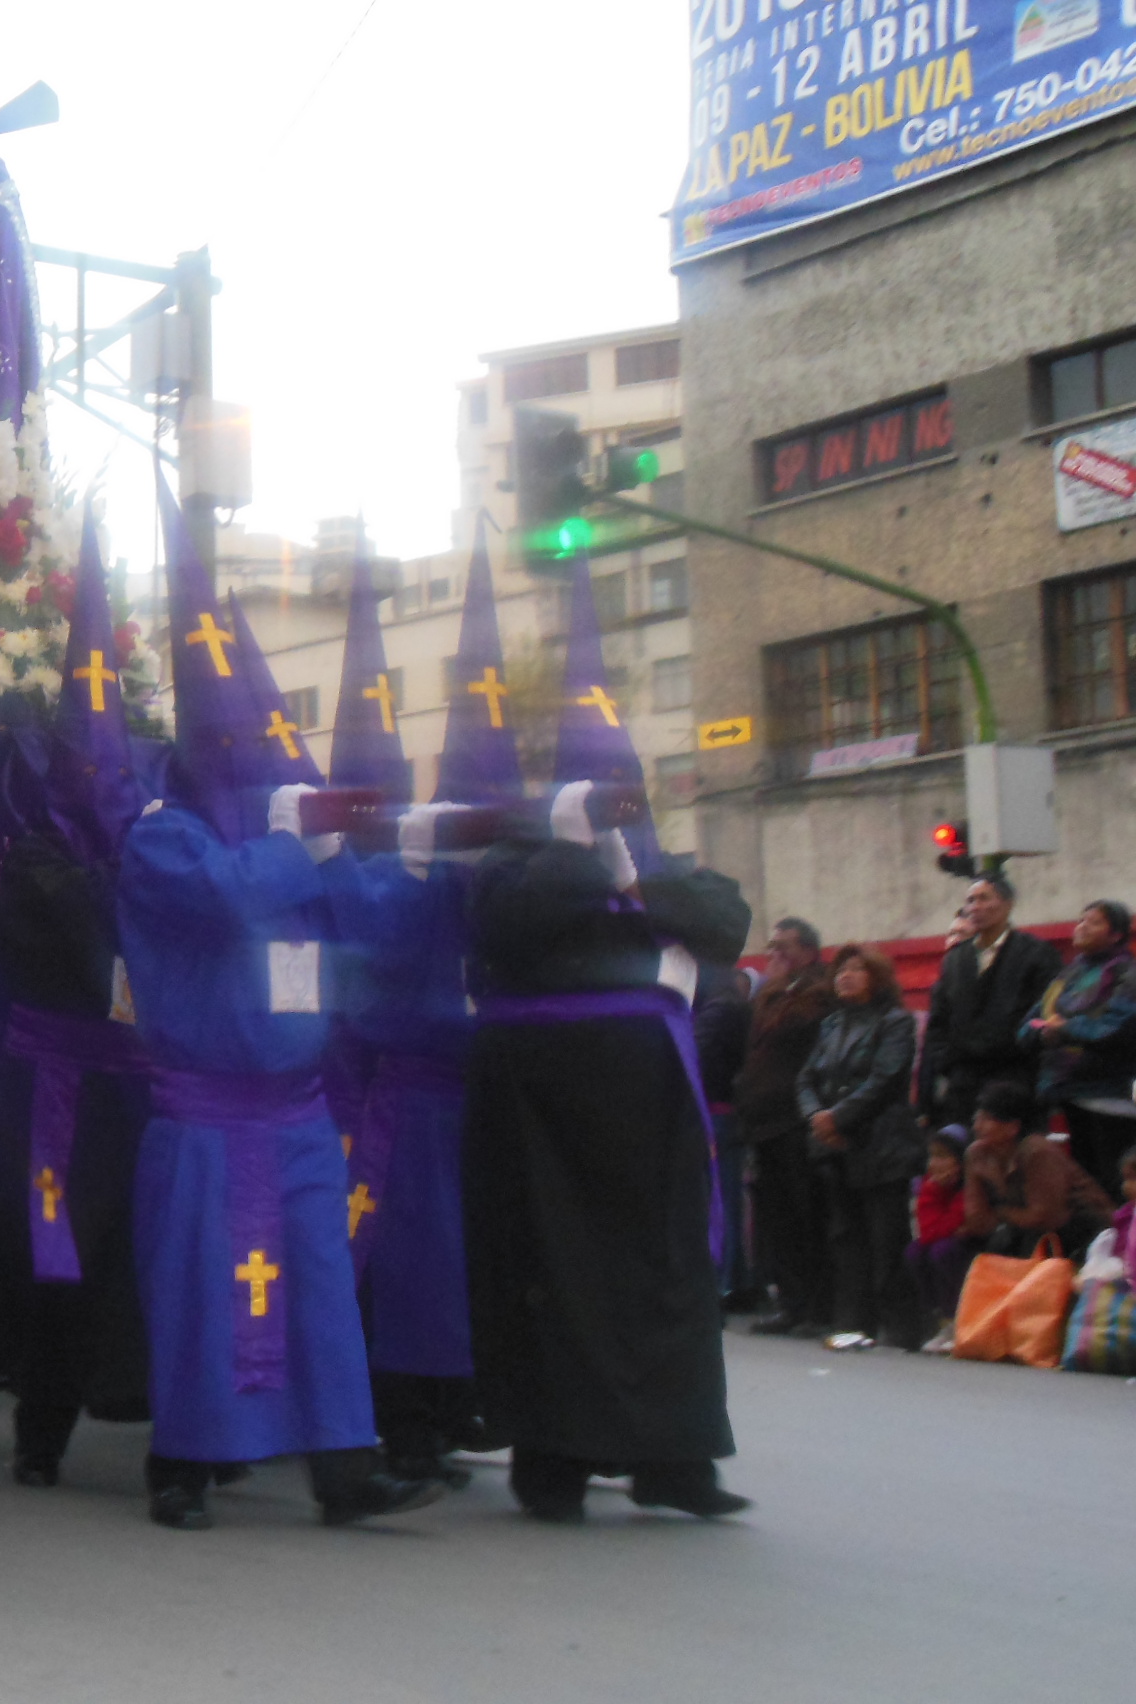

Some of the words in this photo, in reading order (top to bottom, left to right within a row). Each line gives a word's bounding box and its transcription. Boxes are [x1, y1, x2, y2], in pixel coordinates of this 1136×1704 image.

[685, 142, 728, 200] LA
[727, 111, 794, 184] PAZ
[825, 48, 973, 149] BOLIVIA
[693, 83, 731, 148] 09
[771, 44, 821, 108] 12
[838, 0, 979, 85] ABRIL
[900, 105, 982, 154] Cel.:
